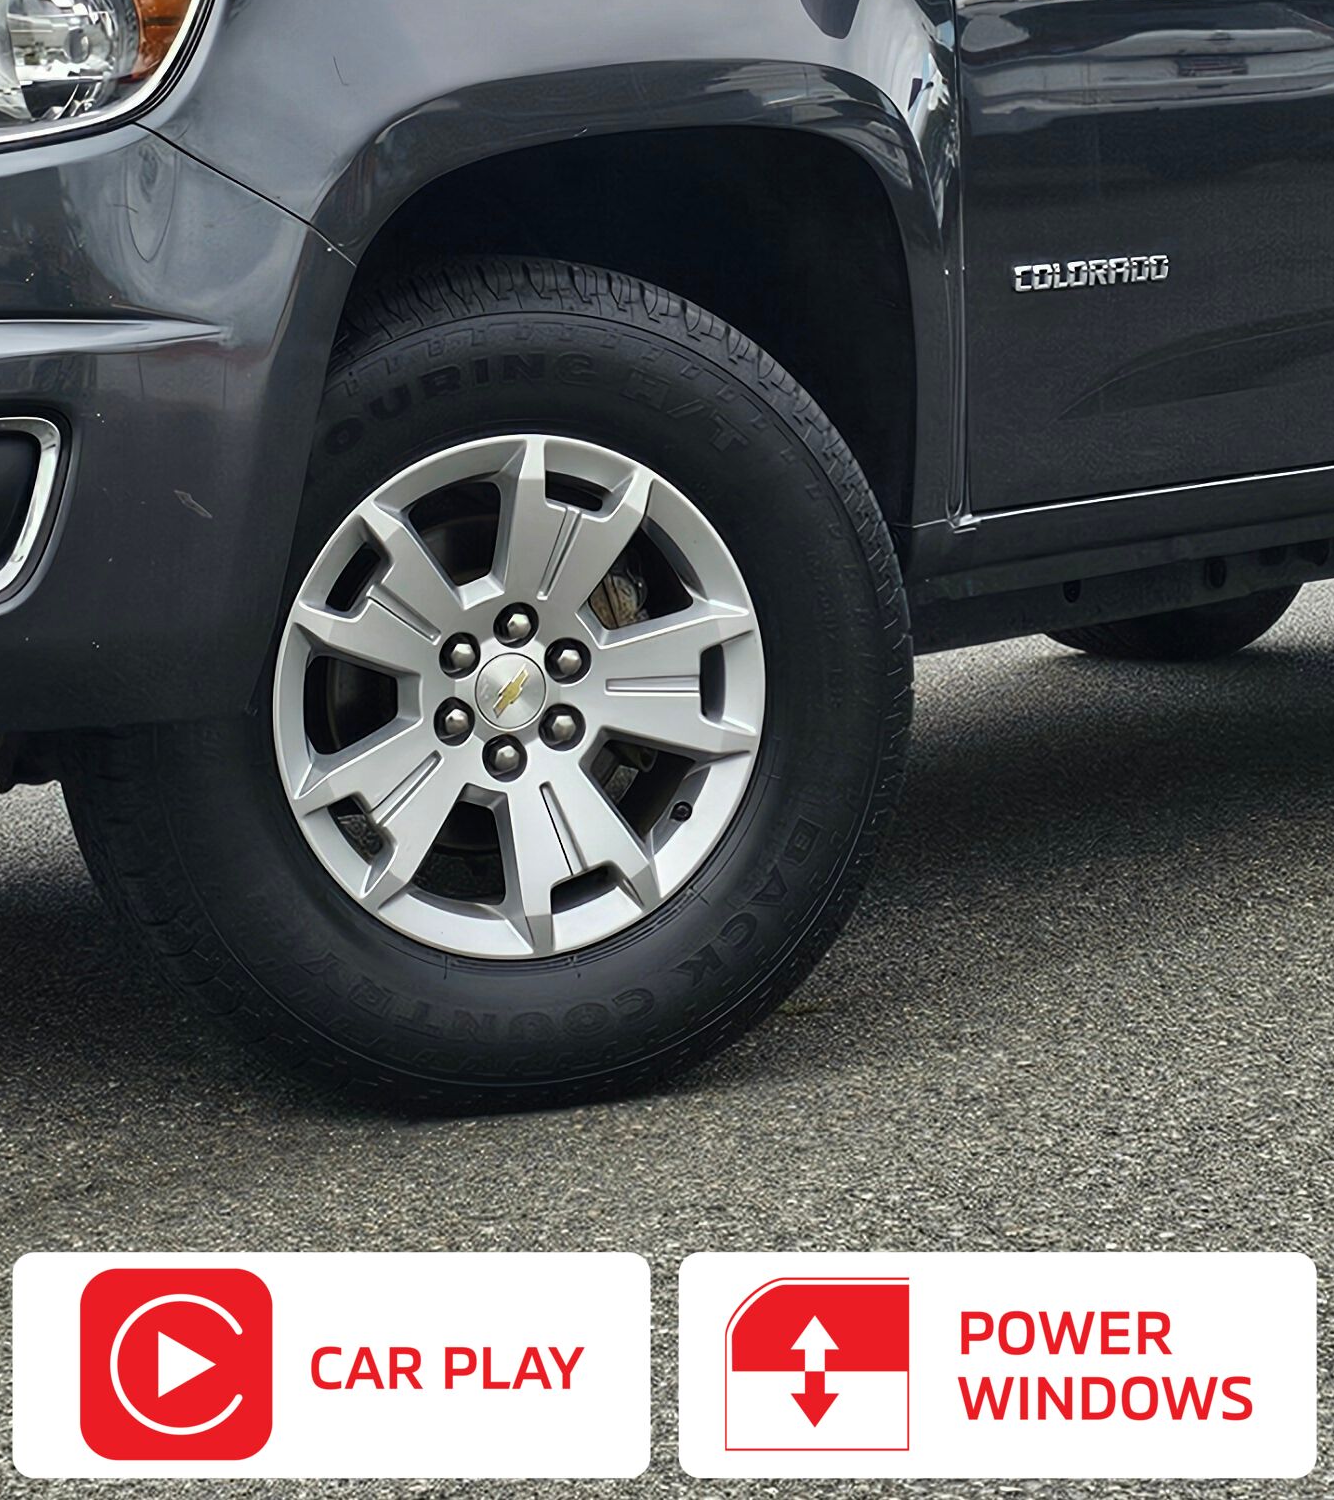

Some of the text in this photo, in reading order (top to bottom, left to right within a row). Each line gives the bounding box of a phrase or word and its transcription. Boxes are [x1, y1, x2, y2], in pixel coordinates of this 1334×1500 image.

[1013, 254, 1169, 292] COLORADO
[322, 350, 602, 459] OURING
[671, 814, 827, 990] BACK
